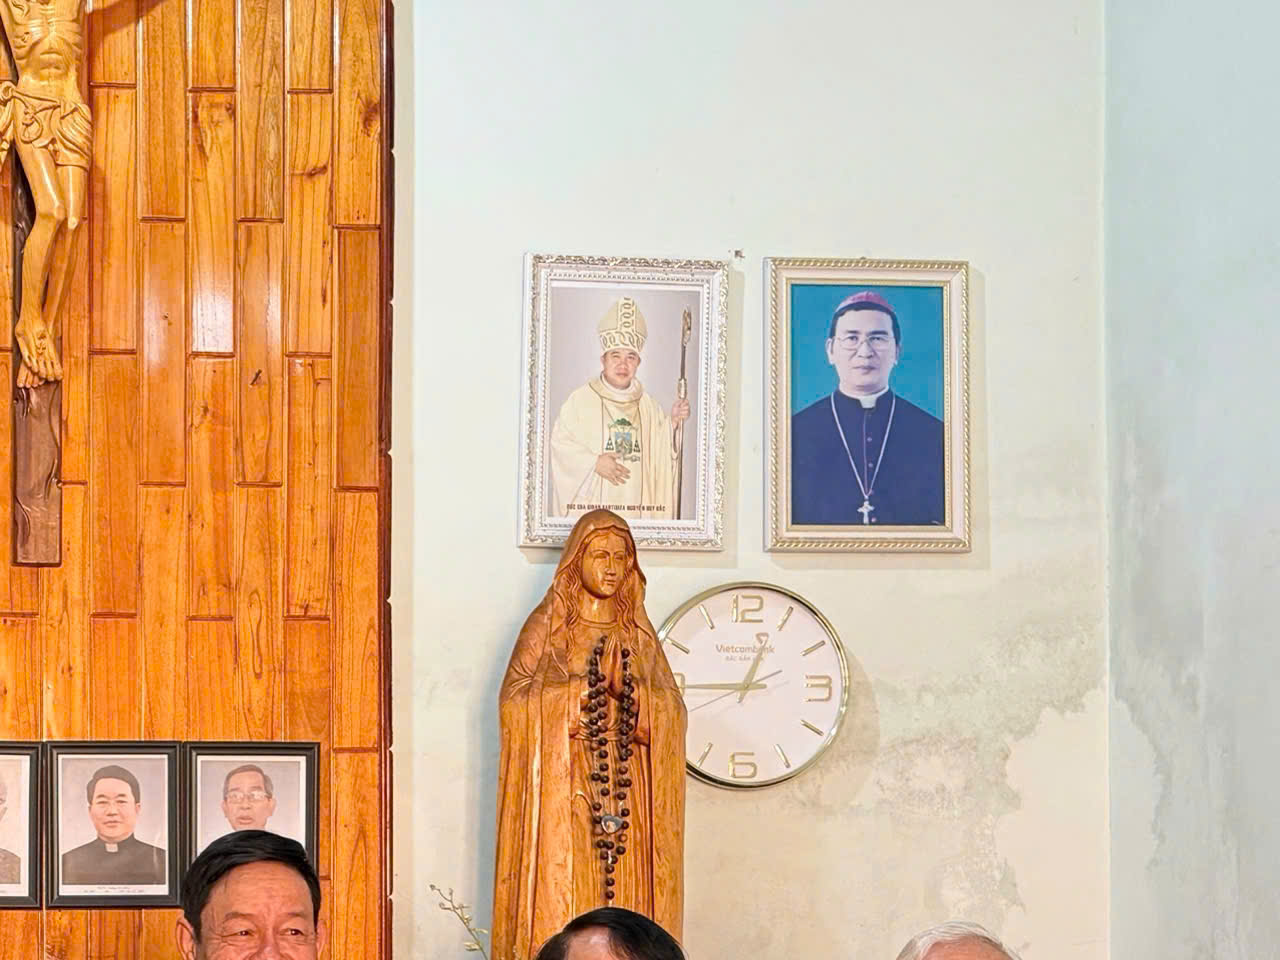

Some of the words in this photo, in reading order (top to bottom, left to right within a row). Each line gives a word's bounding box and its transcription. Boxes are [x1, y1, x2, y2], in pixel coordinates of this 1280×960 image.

[732, 595, 763, 623] 12
[804, 674, 832, 702] 3
[728, 752, 757, 778] 6
